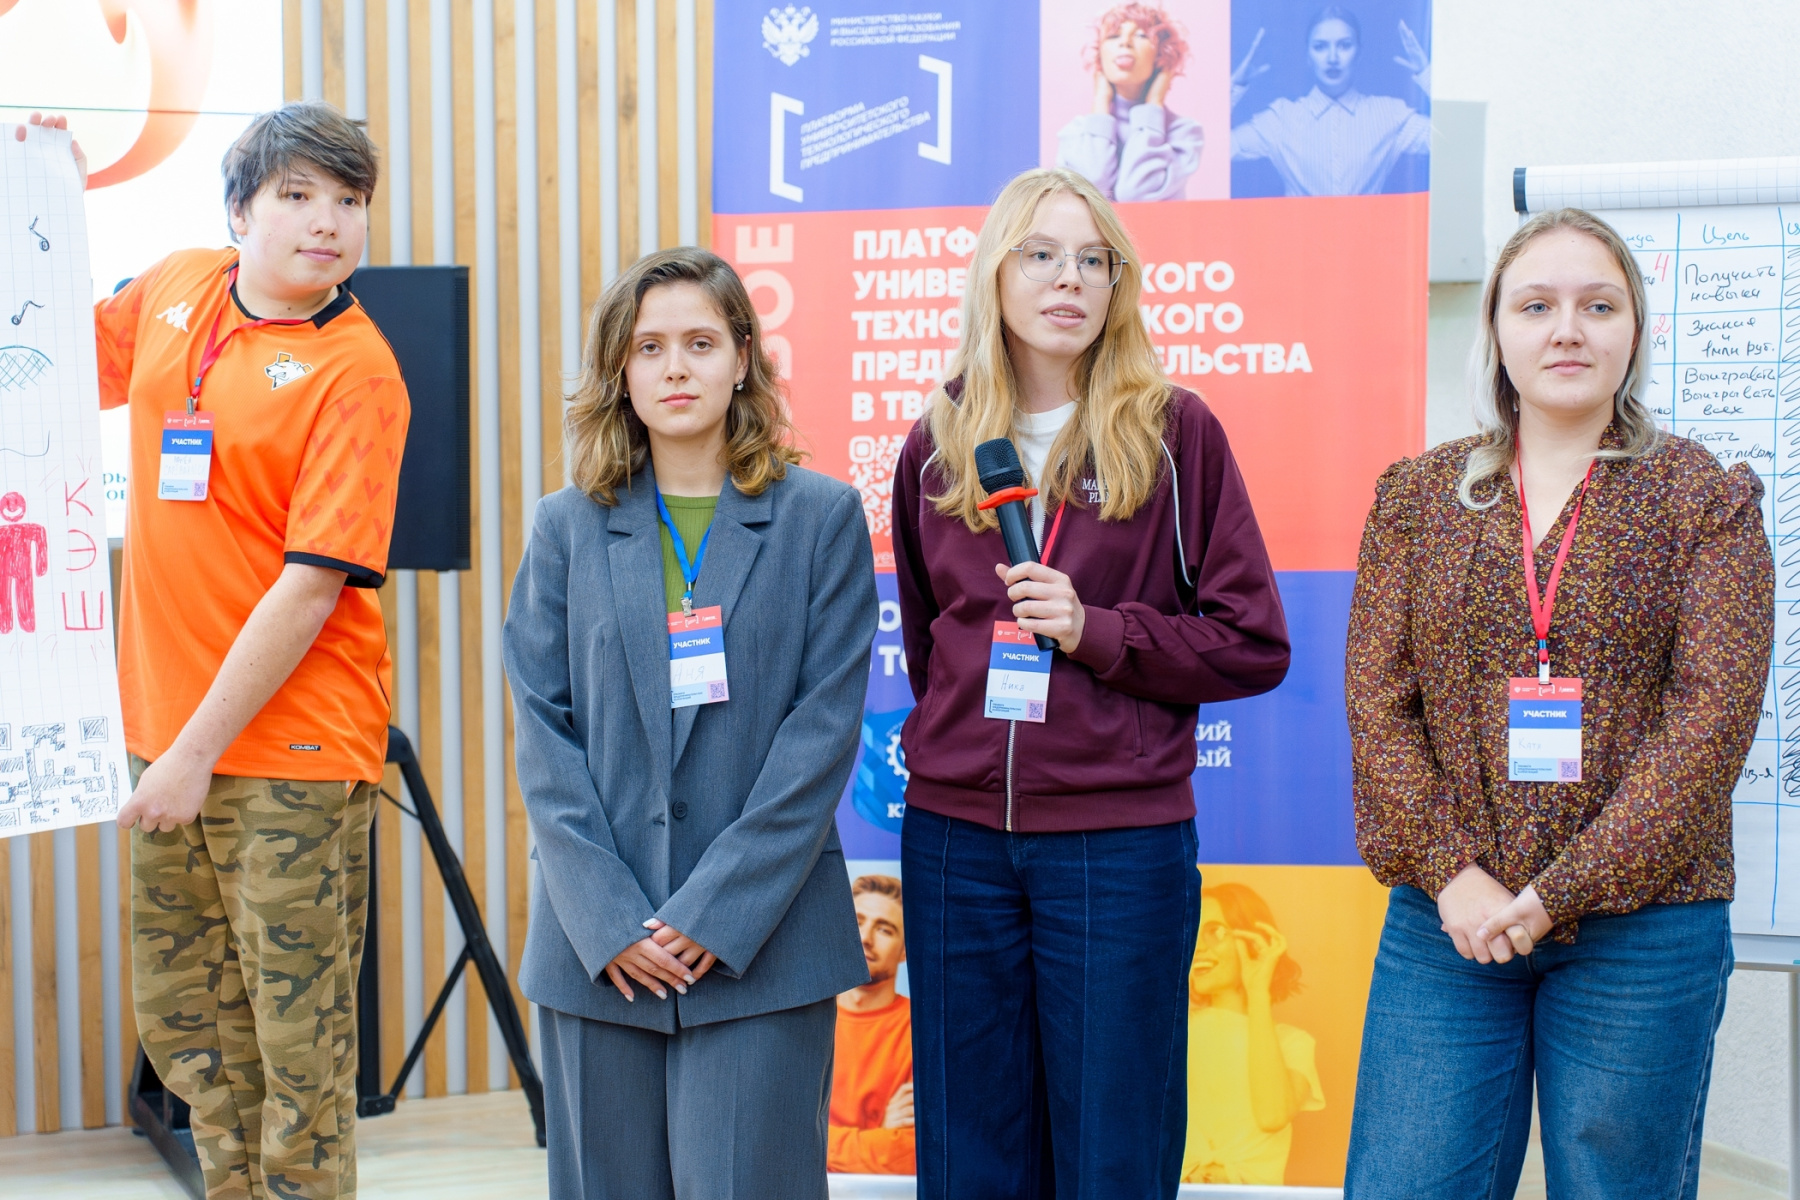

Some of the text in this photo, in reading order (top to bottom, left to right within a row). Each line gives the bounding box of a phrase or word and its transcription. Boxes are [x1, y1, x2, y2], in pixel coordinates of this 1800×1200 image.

[853, 226, 978, 260] ПЛАТФ
[1685, 263, 1776, 288] Получить
[171, 438, 203, 446] УЧАСТНИК
[673, 637, 712, 650] УЧАСТНИК
[1002, 652, 1040, 663] УЧАСТНИК
[1522, 709, 1568, 719] УЧАСТНИК
